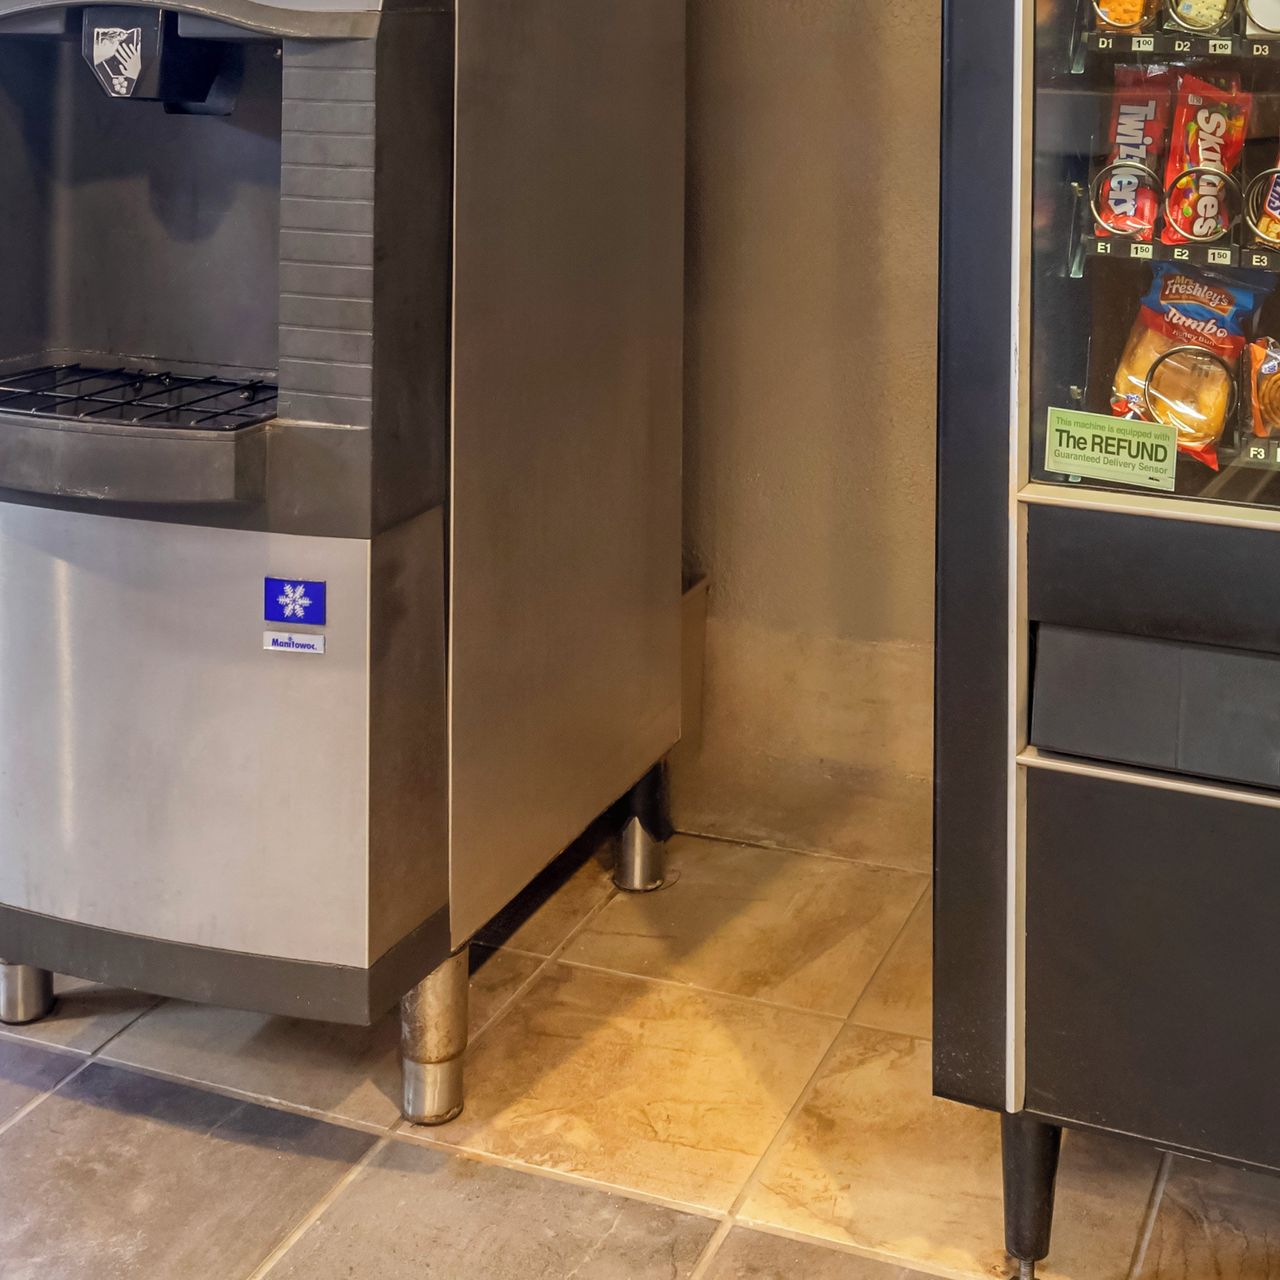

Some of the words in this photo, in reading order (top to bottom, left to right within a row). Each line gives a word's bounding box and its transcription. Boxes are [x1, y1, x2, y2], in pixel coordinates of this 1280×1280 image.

[1098, 38, 1113, 49] D1
[1174, 41, 1191, 52] D2
[1253, 44, 1269, 55] D3
[1097, 242, 1111, 253] E1
[1174, 248, 1189, 259] E2
[1252, 255, 1268, 266] E3
[1165, 279, 1229, 308] Freshley's
[1164, 307, 1228, 338] Jumbo
[1056, 416, 1072, 427] This
[1073, 420, 1107, 432] machine
[1107, 424, 1115, 432] is
[1116, 427, 1152, 440] equipped
[1153, 431, 1170, 441] with
[1055, 428, 1088, 451] The
[1091, 433, 1169, 463] REFUND
[1249, 448, 1265, 459] F3
[1054, 448, 1101, 464] Guaranteed
[1102, 456, 1137, 471] Delivery
[1138, 462, 1169, 475] Sensor
[271, 636, 316, 651] Manitowoc
